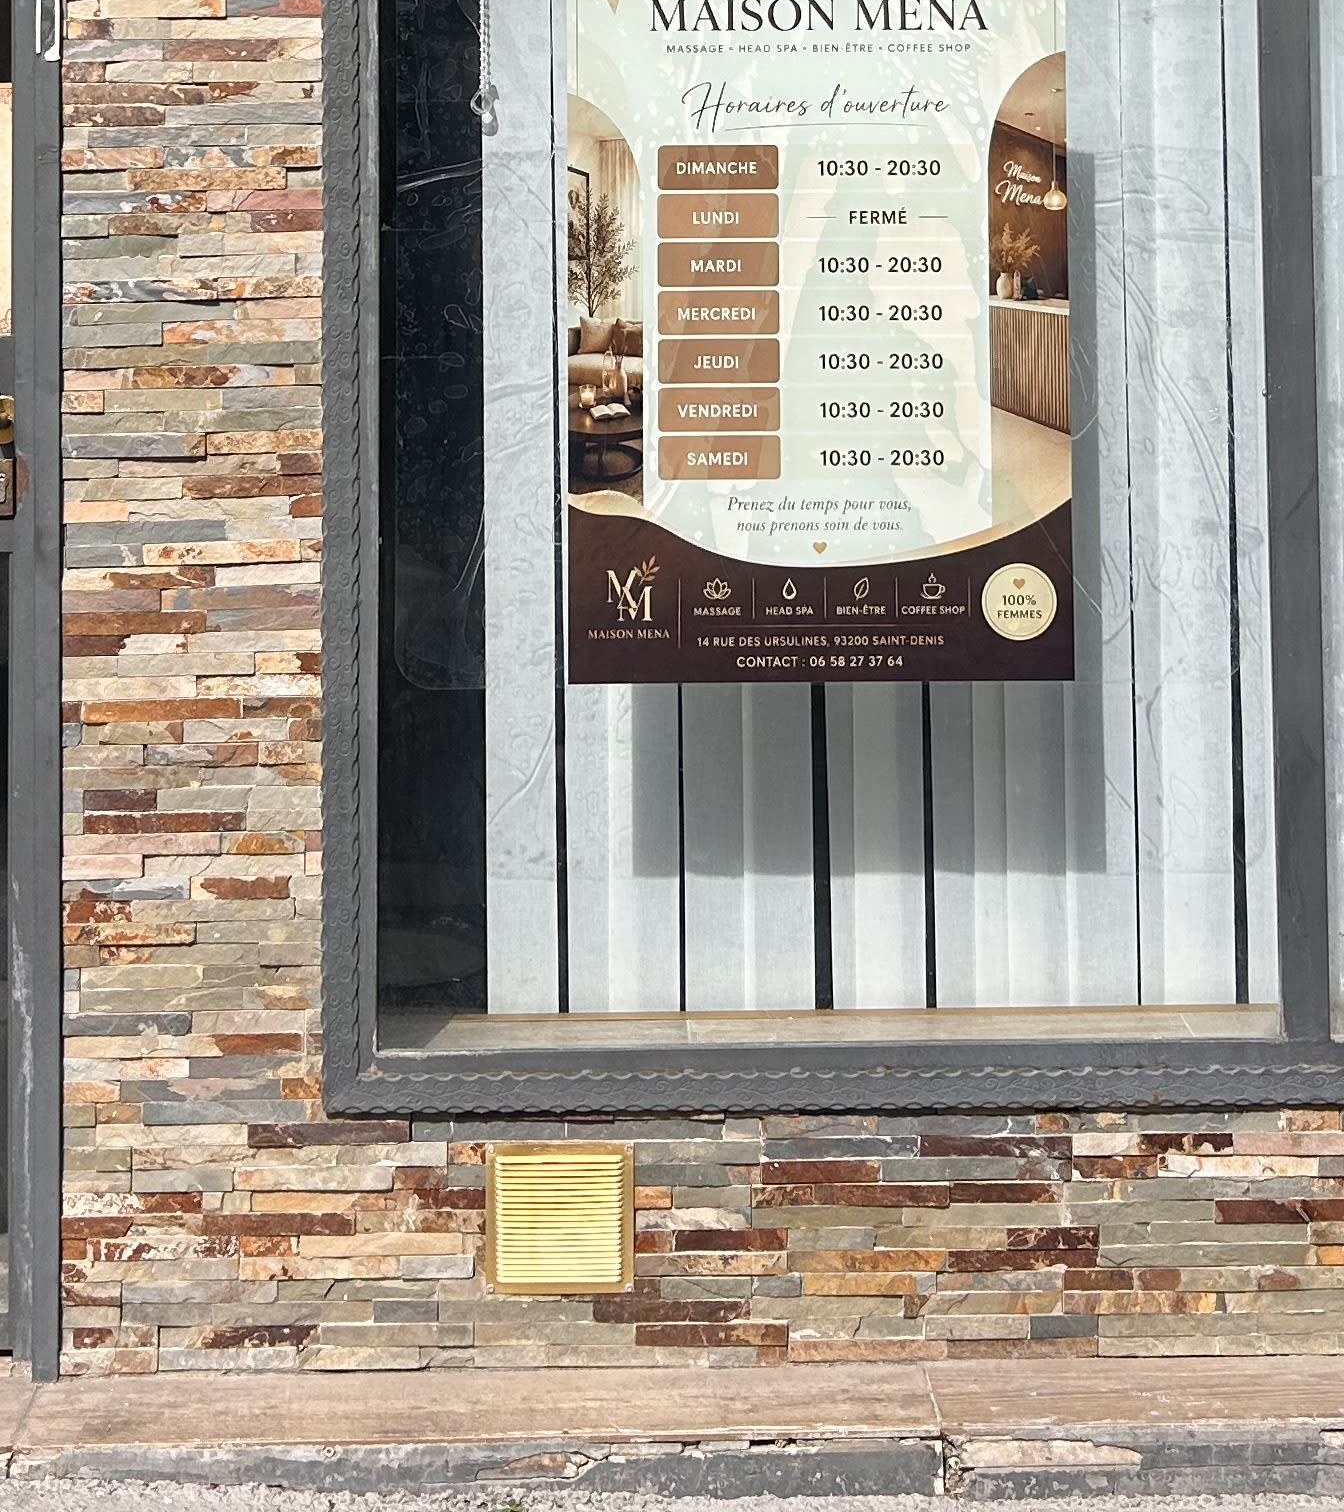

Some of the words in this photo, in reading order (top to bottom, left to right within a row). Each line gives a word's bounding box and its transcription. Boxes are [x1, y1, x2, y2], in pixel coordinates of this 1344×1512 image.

[666, 44, 724, 54] MASSAGE
[738, 44, 771, 53] HEAD
[777, 44, 798, 53] SPA
[887, 43, 934, 53] COFFEE
[938, 43, 971, 53] SHOP
[681, 81, 813, 133] Horaires
[820, 83, 950, 119] d'ouverture
[676, 161, 757, 175] DIMANCHE
[817, 160, 869, 177] 10:30
[886, 160, 942, 177] 20:30
[994, 179, 1045, 206] Mena
[692, 211, 739, 225] LUNDI
[849, 207, 907, 225] FERMÉ
[690, 259, 742, 273] MARDI
[818, 257, 869, 274] 10:30
[887, 257, 943, 274] 20:30
[677, 307, 756, 321] MERCREDI
[818, 305, 870, 322] 10:30
[888, 305, 943, 322] 20:30
[693, 355, 739, 369] JEUDI
[819, 353, 870, 370] 10:30
[888, 353, 944, 370] 20:30
[677, 403, 758, 418] VENDREDI
[819, 401, 871, 418] 10:30
[889, 401, 944, 418] 20:30
[687, 451, 748, 466] SAMEDI
[820, 449, 871, 466] 10:30
[889, 449, 945, 466] 20:30
[727, 496, 775, 513] Prenez
[778, 496, 796, 511] du
[800, 498, 839, 515] temps
[841, 499, 875, 515] pour
[879, 500, 912, 512] vous,
[736, 521, 766, 532] nous
[769, 521, 820, 536] prenons
[824, 518, 849, 531] soin
[853, 516, 868, 531] de
[1002, 595, 1037, 606] 100%
[693, 607, 742, 616] MASSAGE
[765, 606, 793, 616] HEAD
[796, 606, 814, 615] SPA
[836, 604, 886, 615] BIEN-ÊTRE
[901, 606, 937, 615] COFFEE
[939, 606, 966, 615] SHOP
[997, 610, 1043, 619] FEMMES
[588, 629, 634, 640] MAISON
[637, 629, 671, 639] MENA
[697, 637, 710, 647] 14
[713, 637, 735, 647] RUE
[738, 636, 761, 647] DES
[764, 636, 830, 648] URSULINES,
[834, 635, 869, 646] 93200
[872, 635, 945, 646] SAINT-DENIS
[736, 656, 799, 668] CONTACT
[809, 656, 826, 668] 06
[830, 656, 846, 668] 58
[849, 656, 865, 668] 27
[868, 655, 884, 667] 37
[887, 655, 904, 667] 64
